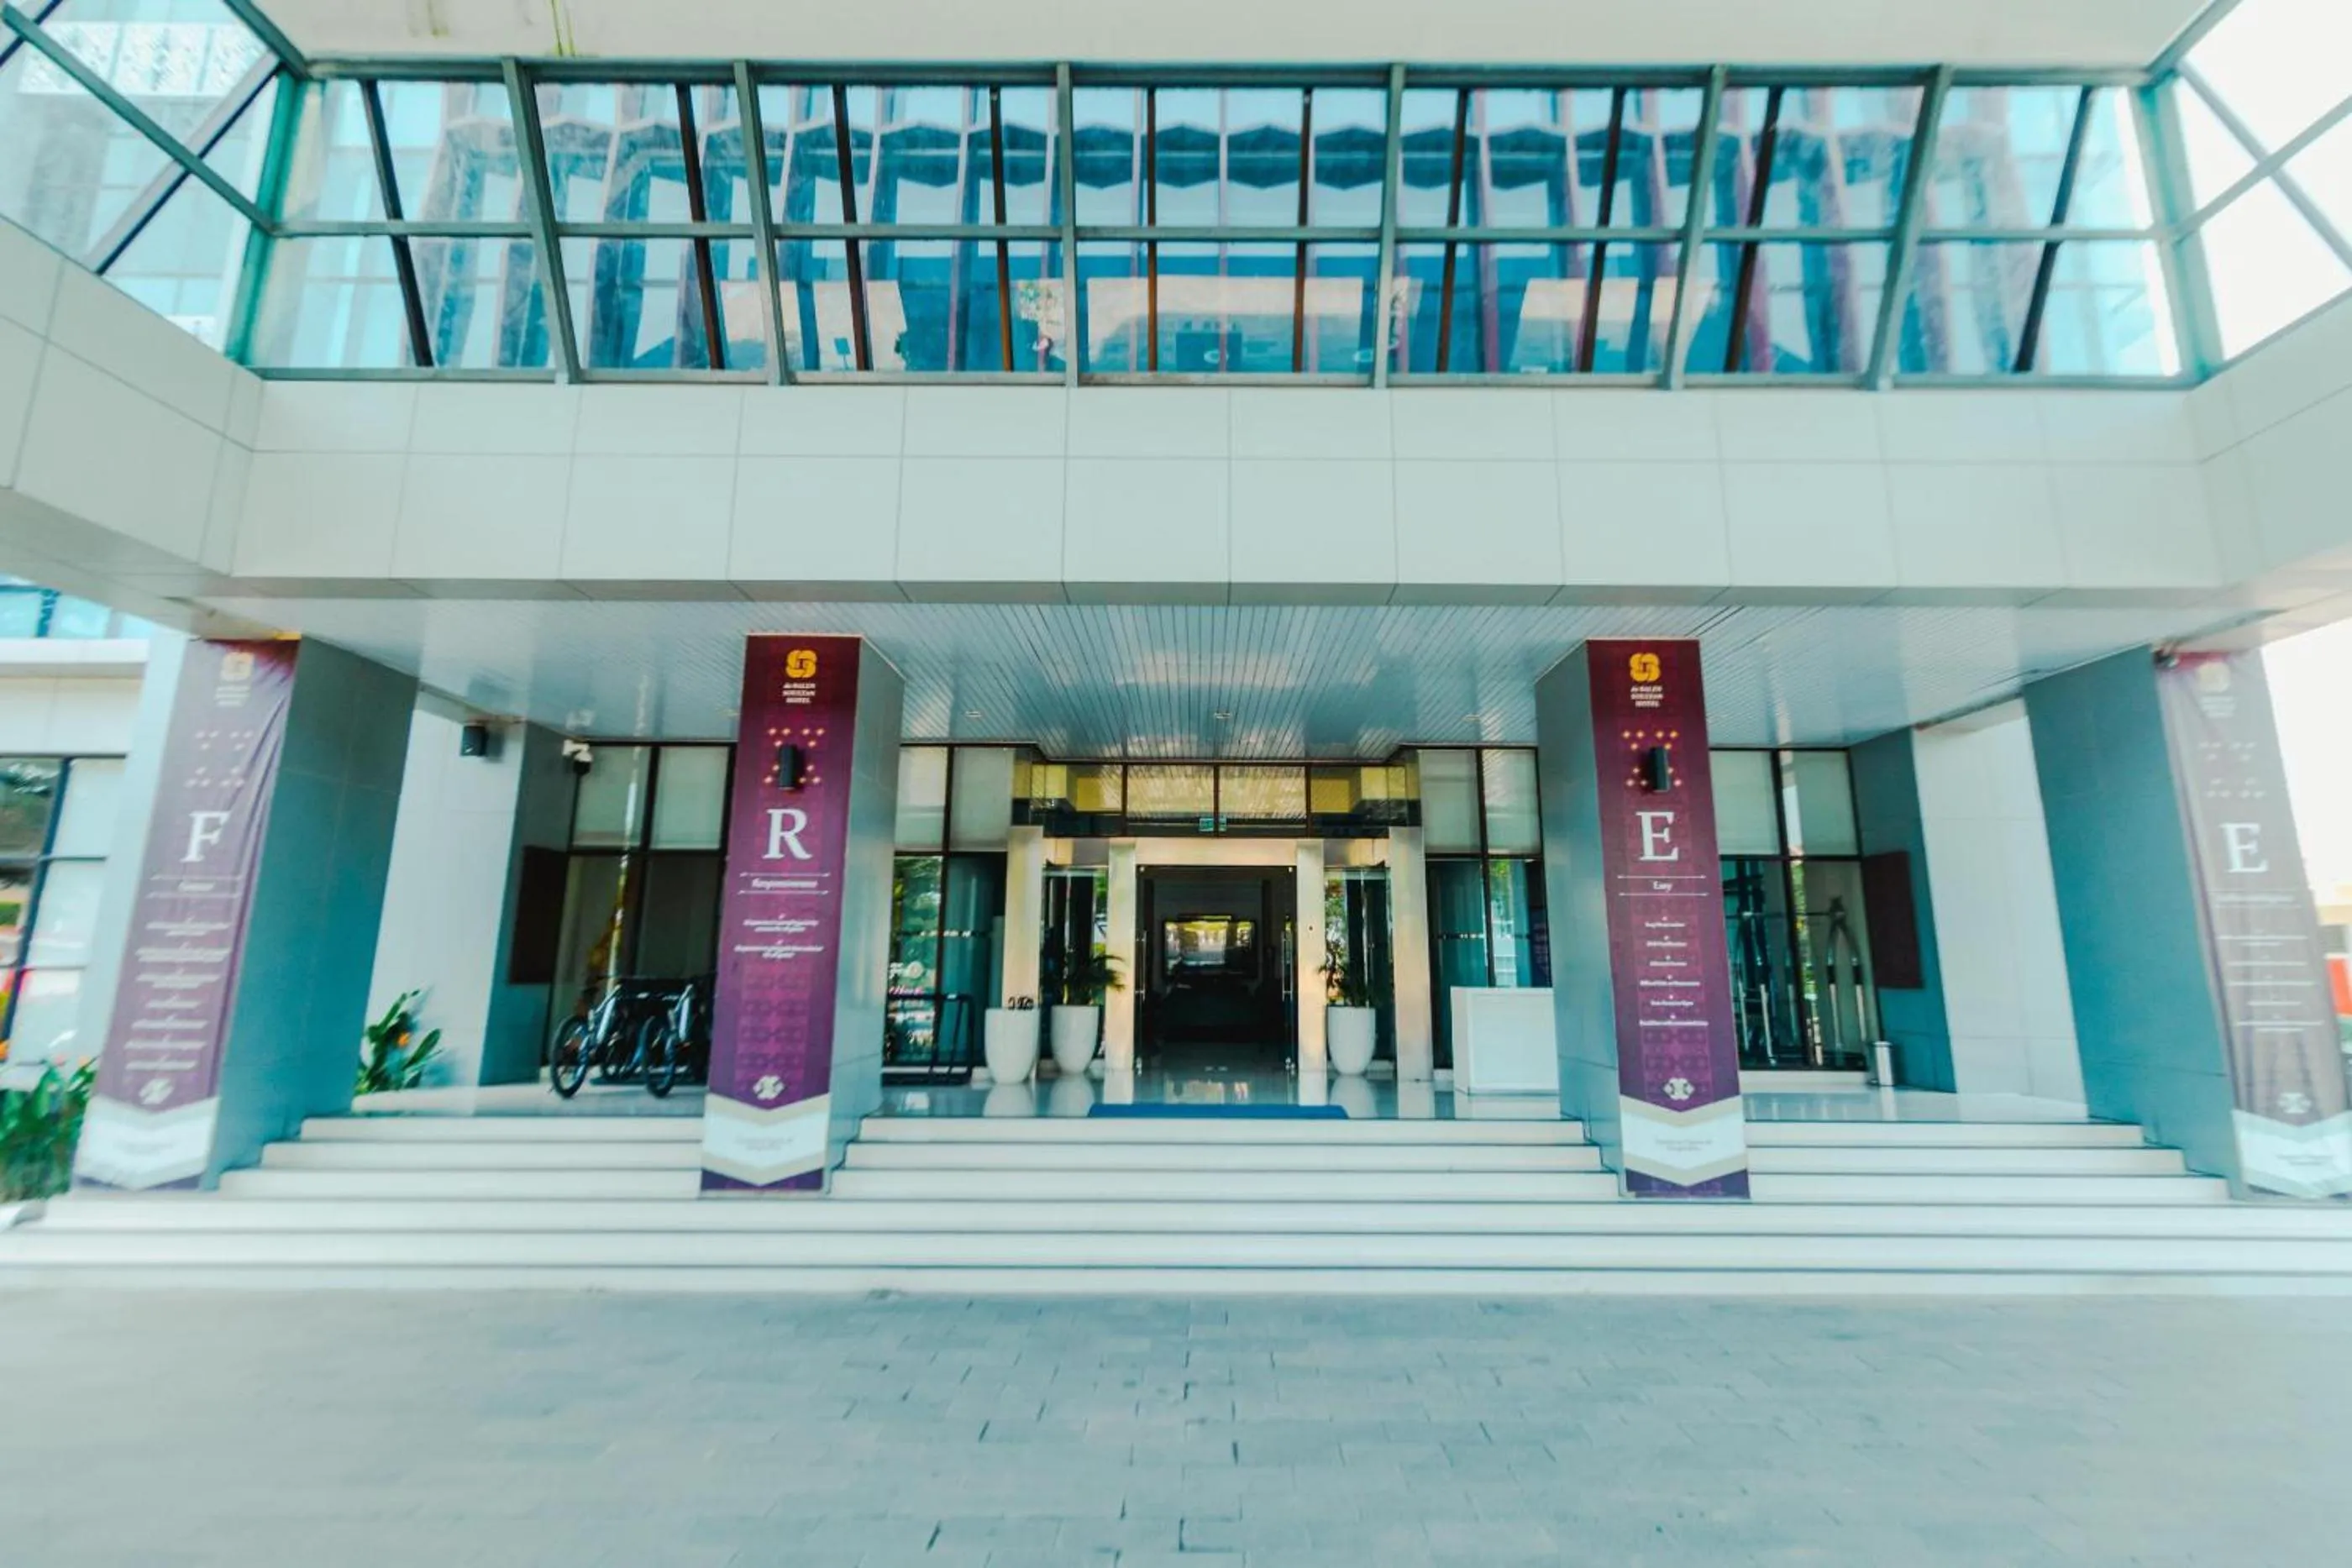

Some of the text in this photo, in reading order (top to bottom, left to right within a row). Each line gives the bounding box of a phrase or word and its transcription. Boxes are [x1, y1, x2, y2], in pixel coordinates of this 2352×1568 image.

[179, 810, 231, 863] F
[762, 808, 813, 860] R
[1635, 811, 1678, 861] E
[2218, 822, 2270, 874] E
